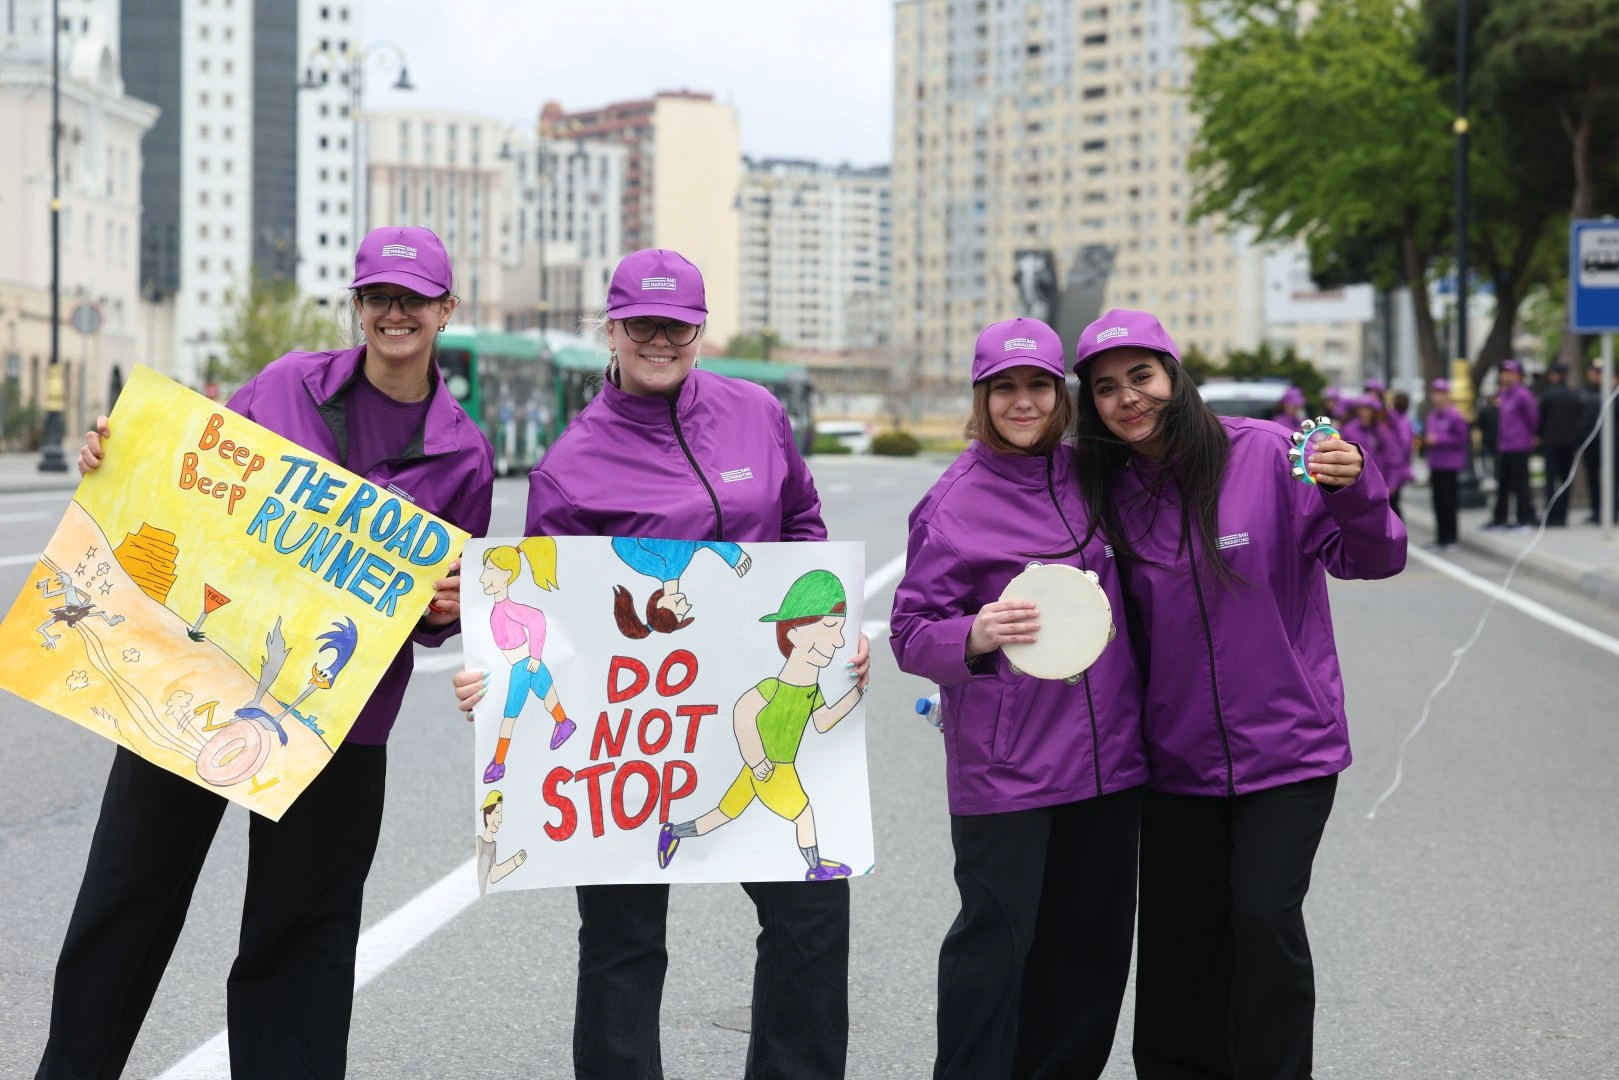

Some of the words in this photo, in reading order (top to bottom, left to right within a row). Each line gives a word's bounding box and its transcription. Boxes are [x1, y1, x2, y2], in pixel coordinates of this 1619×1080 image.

[198, 413, 265, 483] Beep
[179, 451, 247, 516] Beep
[274, 454, 348, 515] THE
[335, 482, 451, 567] ROAD
[246, 496, 415, 618] RUNNER
[207, 589, 225, 606] YIELD
[606, 648, 699, 704] DO
[589, 704, 719, 761] NOT
[541, 759, 698, 842] STOP
